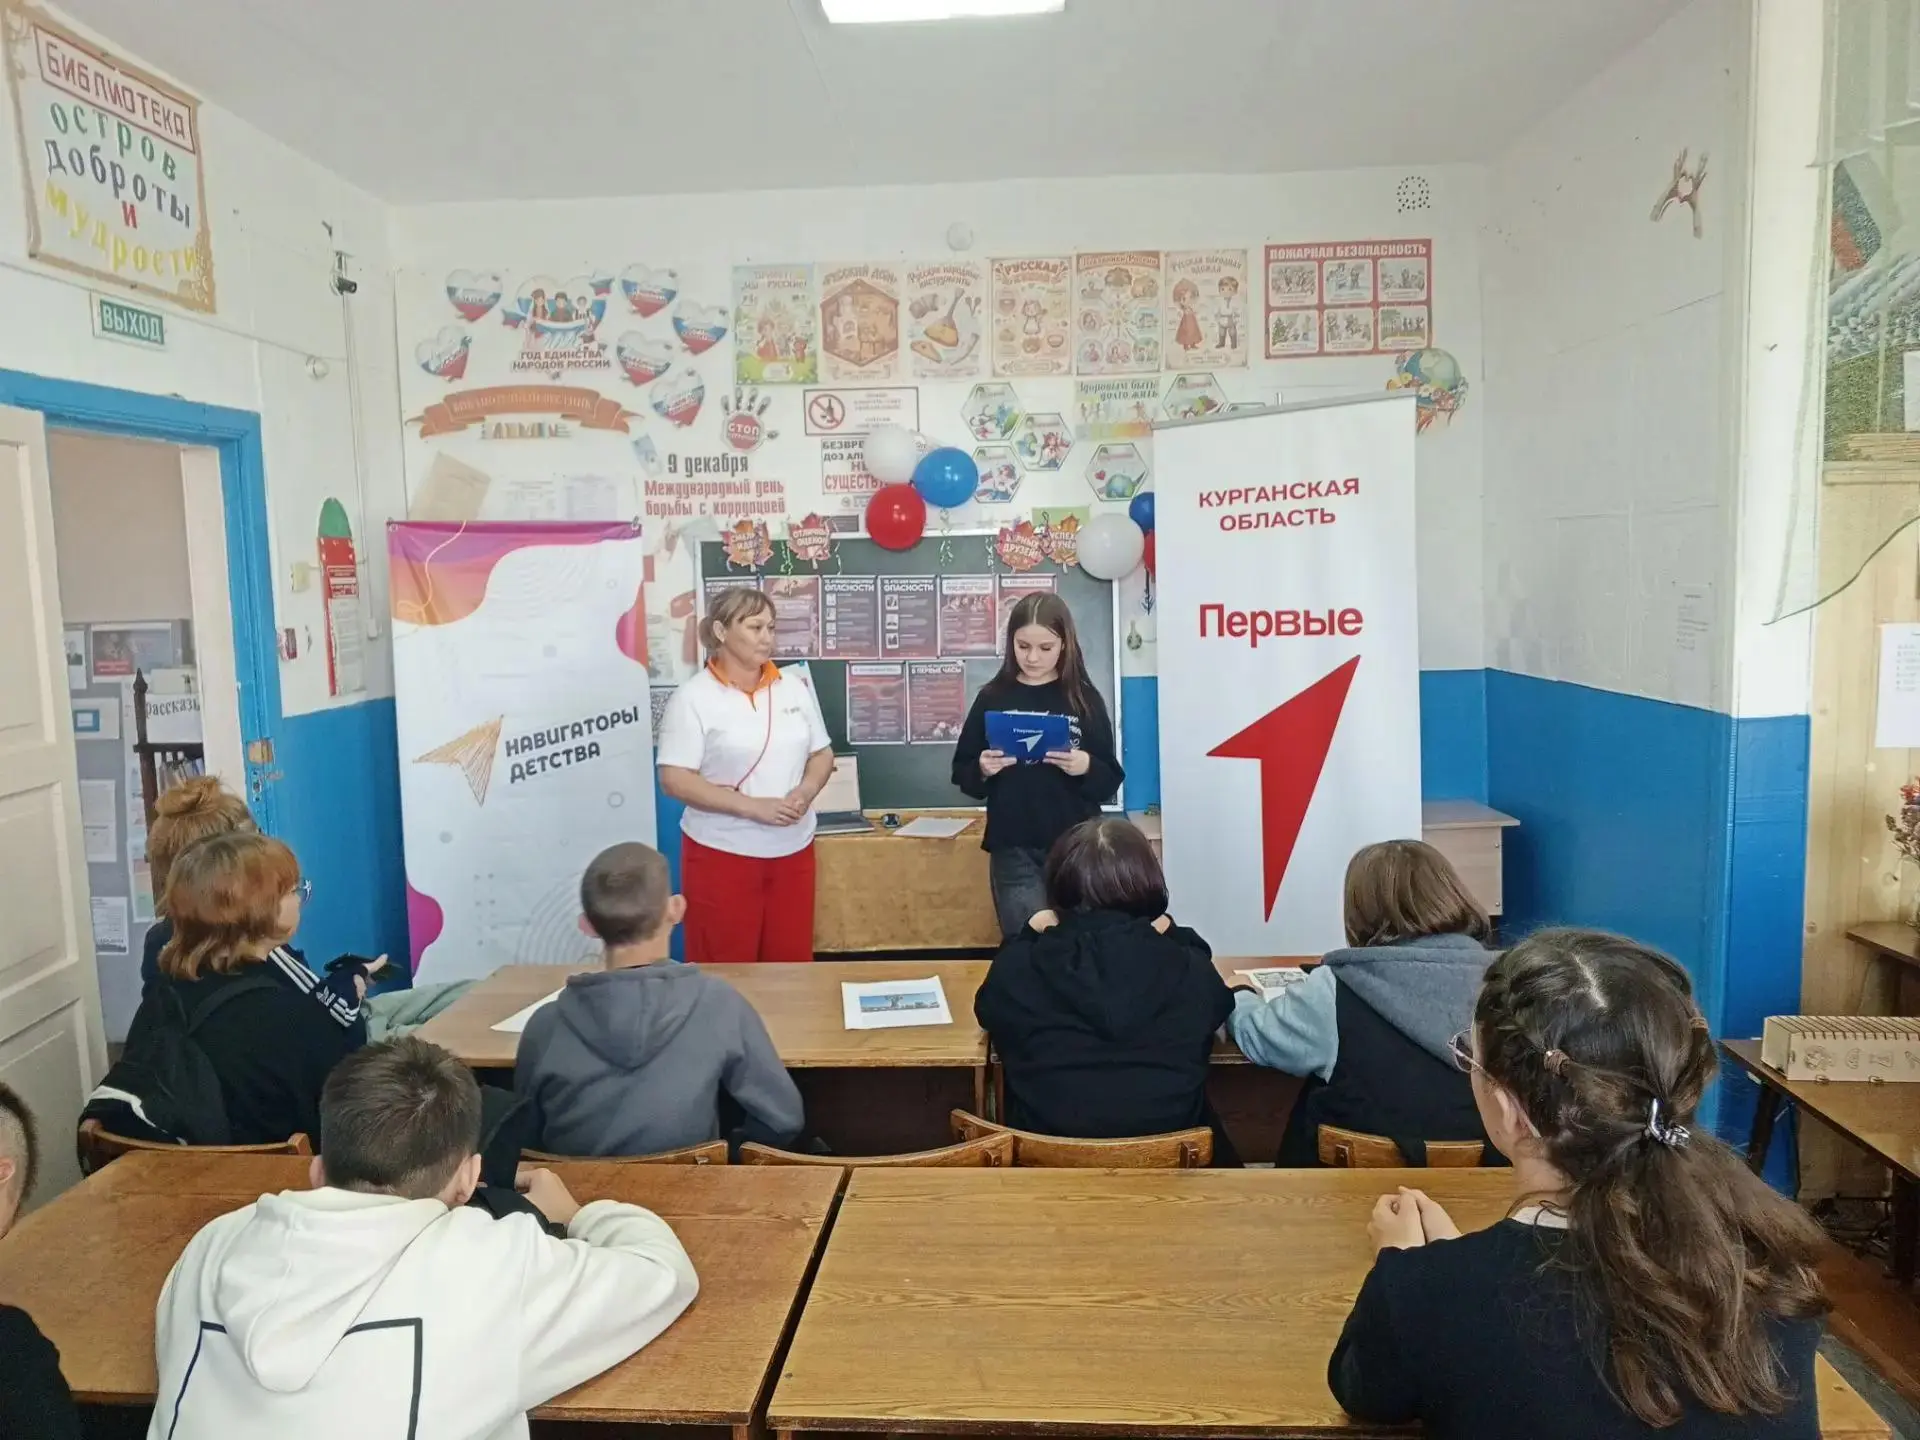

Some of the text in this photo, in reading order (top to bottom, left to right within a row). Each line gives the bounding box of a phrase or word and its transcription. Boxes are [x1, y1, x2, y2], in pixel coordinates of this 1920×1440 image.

[46, 41, 186, 141] БИБЛИОТЕКА
[1269, 243, 1427, 260] ПОЖАРНАЯ БЕЗОПАСНОСТЬ
[102, 308, 162, 342] ВЫХОД
[512, 359, 611, 370] НАРОДОВ РОССИИ
[520, 350, 602, 361] ГОД ЕДИНСТВА
[728, 423, 759, 436] СТОП
[822, 440, 865, 450] БЕЗВРЕ
[667, 452, 749, 478] 9 декабря
[823, 452, 844, 462] ДОЗ
[644, 479, 785, 499] Международный день
[1199, 477, 1360, 508] КУРГАНСКАЯ
[645, 499, 693, 519] борьбы
[713, 497, 786, 518] коррупцией
[1219, 507, 1337, 532] ОБЛАСТЬ
[824, 583, 875, 593] ОПАСНОСТИ
[883, 583, 935, 593] ОПАСНОСТИ
[1199, 603, 1364, 649] Первые
[505, 706, 638, 757] НАВИГАТОРЫ
[510, 741, 602, 784] ДЕТСТВА
